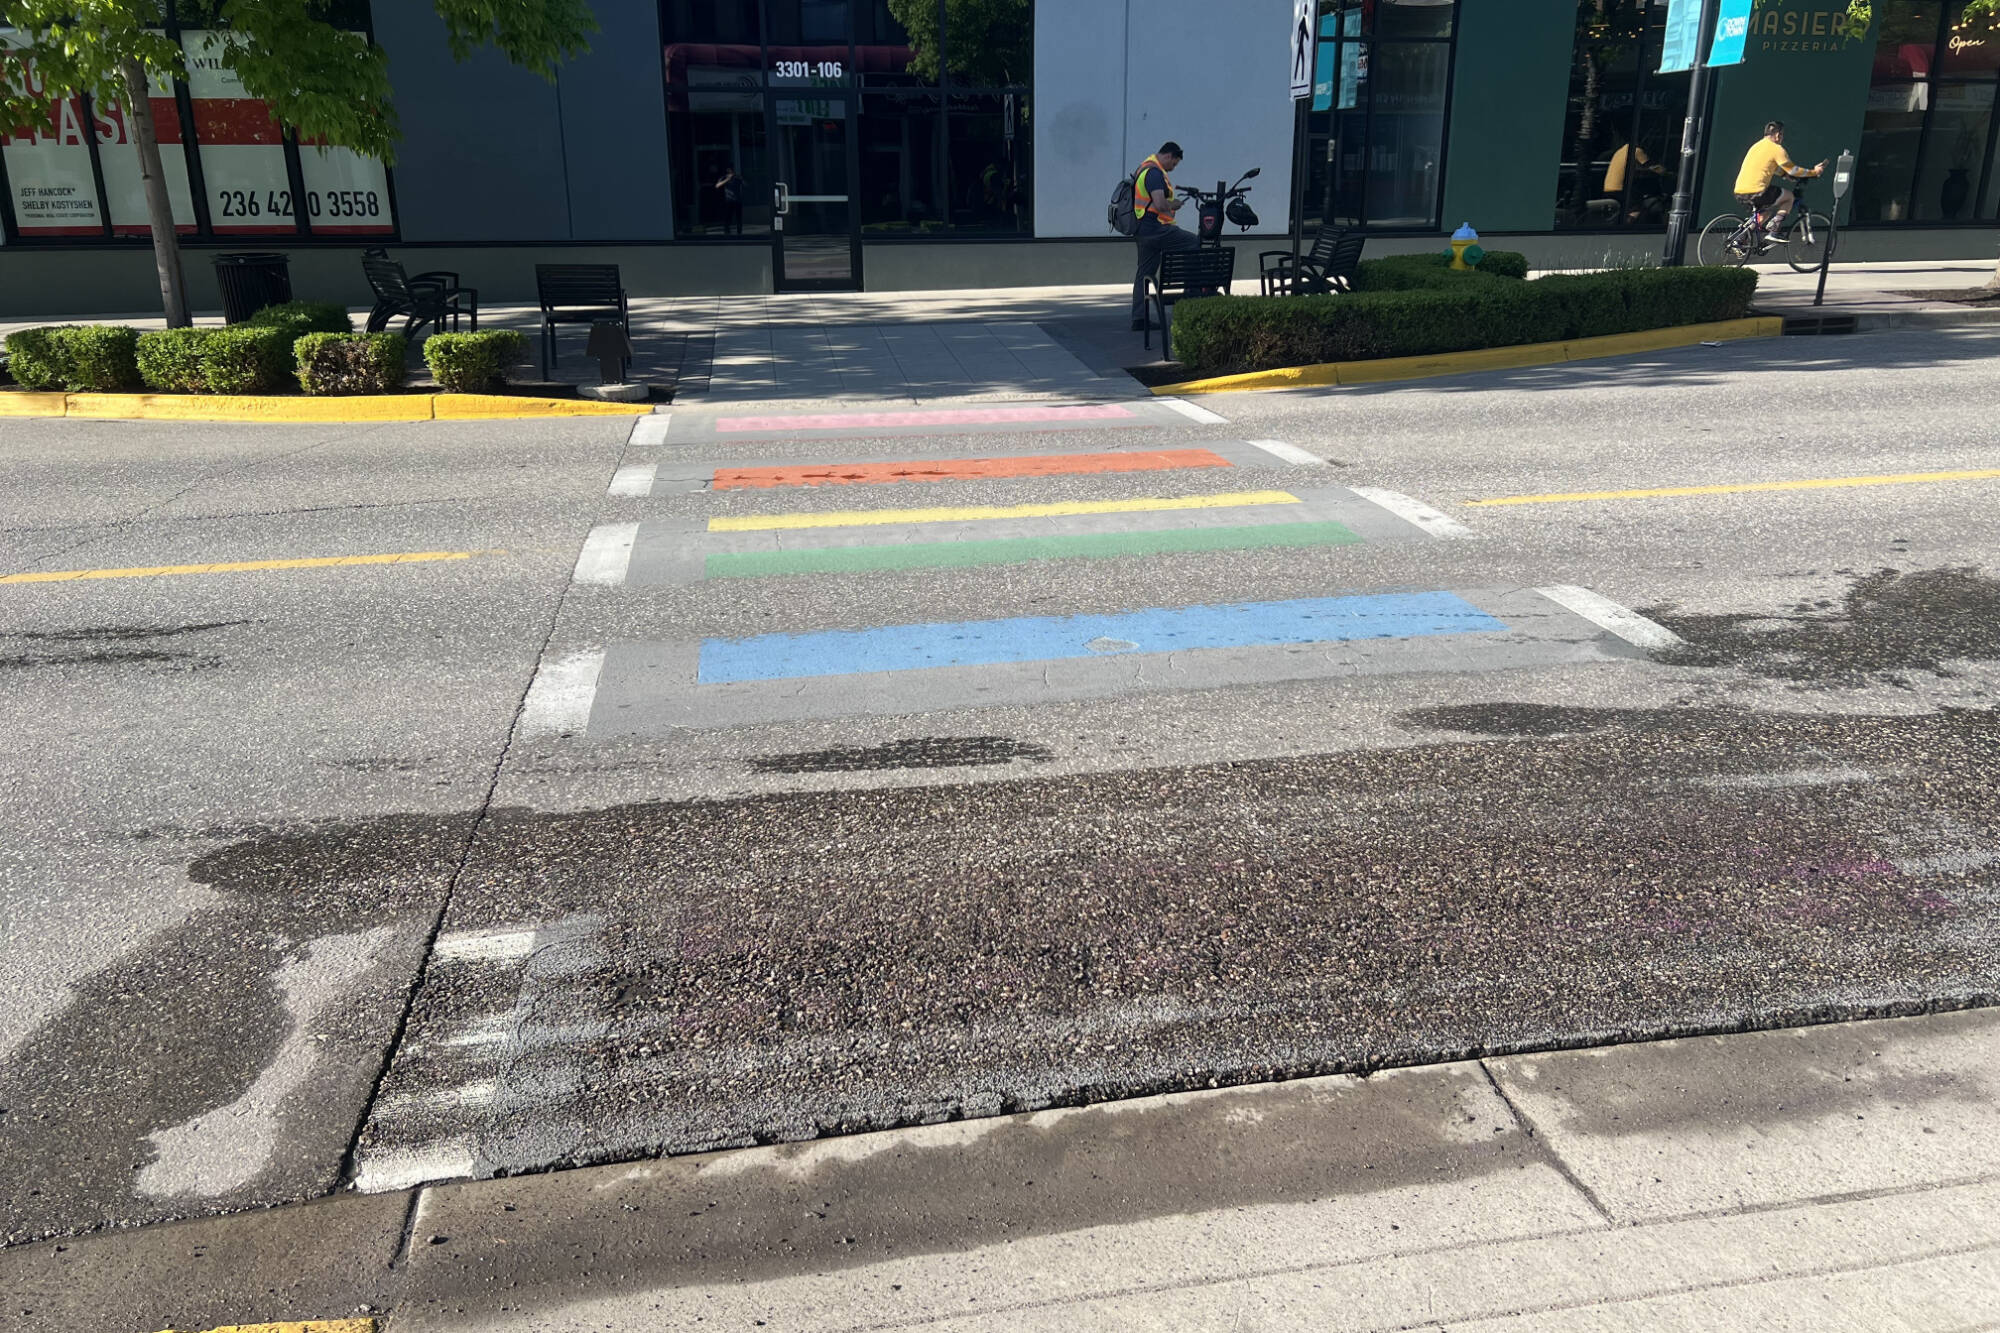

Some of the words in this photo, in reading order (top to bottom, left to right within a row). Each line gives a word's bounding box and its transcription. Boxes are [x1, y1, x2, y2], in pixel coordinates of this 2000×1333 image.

[1749, 10, 1870, 36] MASIER
[1762, 41, 1838, 52] PIZZERIA
[1948, 36, 1985, 55] Open
[776, 61, 842, 78] 3301-106
[20, 187, 37, 197] JEFF
[22, 200, 49, 210] SHELBY
[219, 191, 260, 217] 236
[328, 191, 379, 217] 3558
